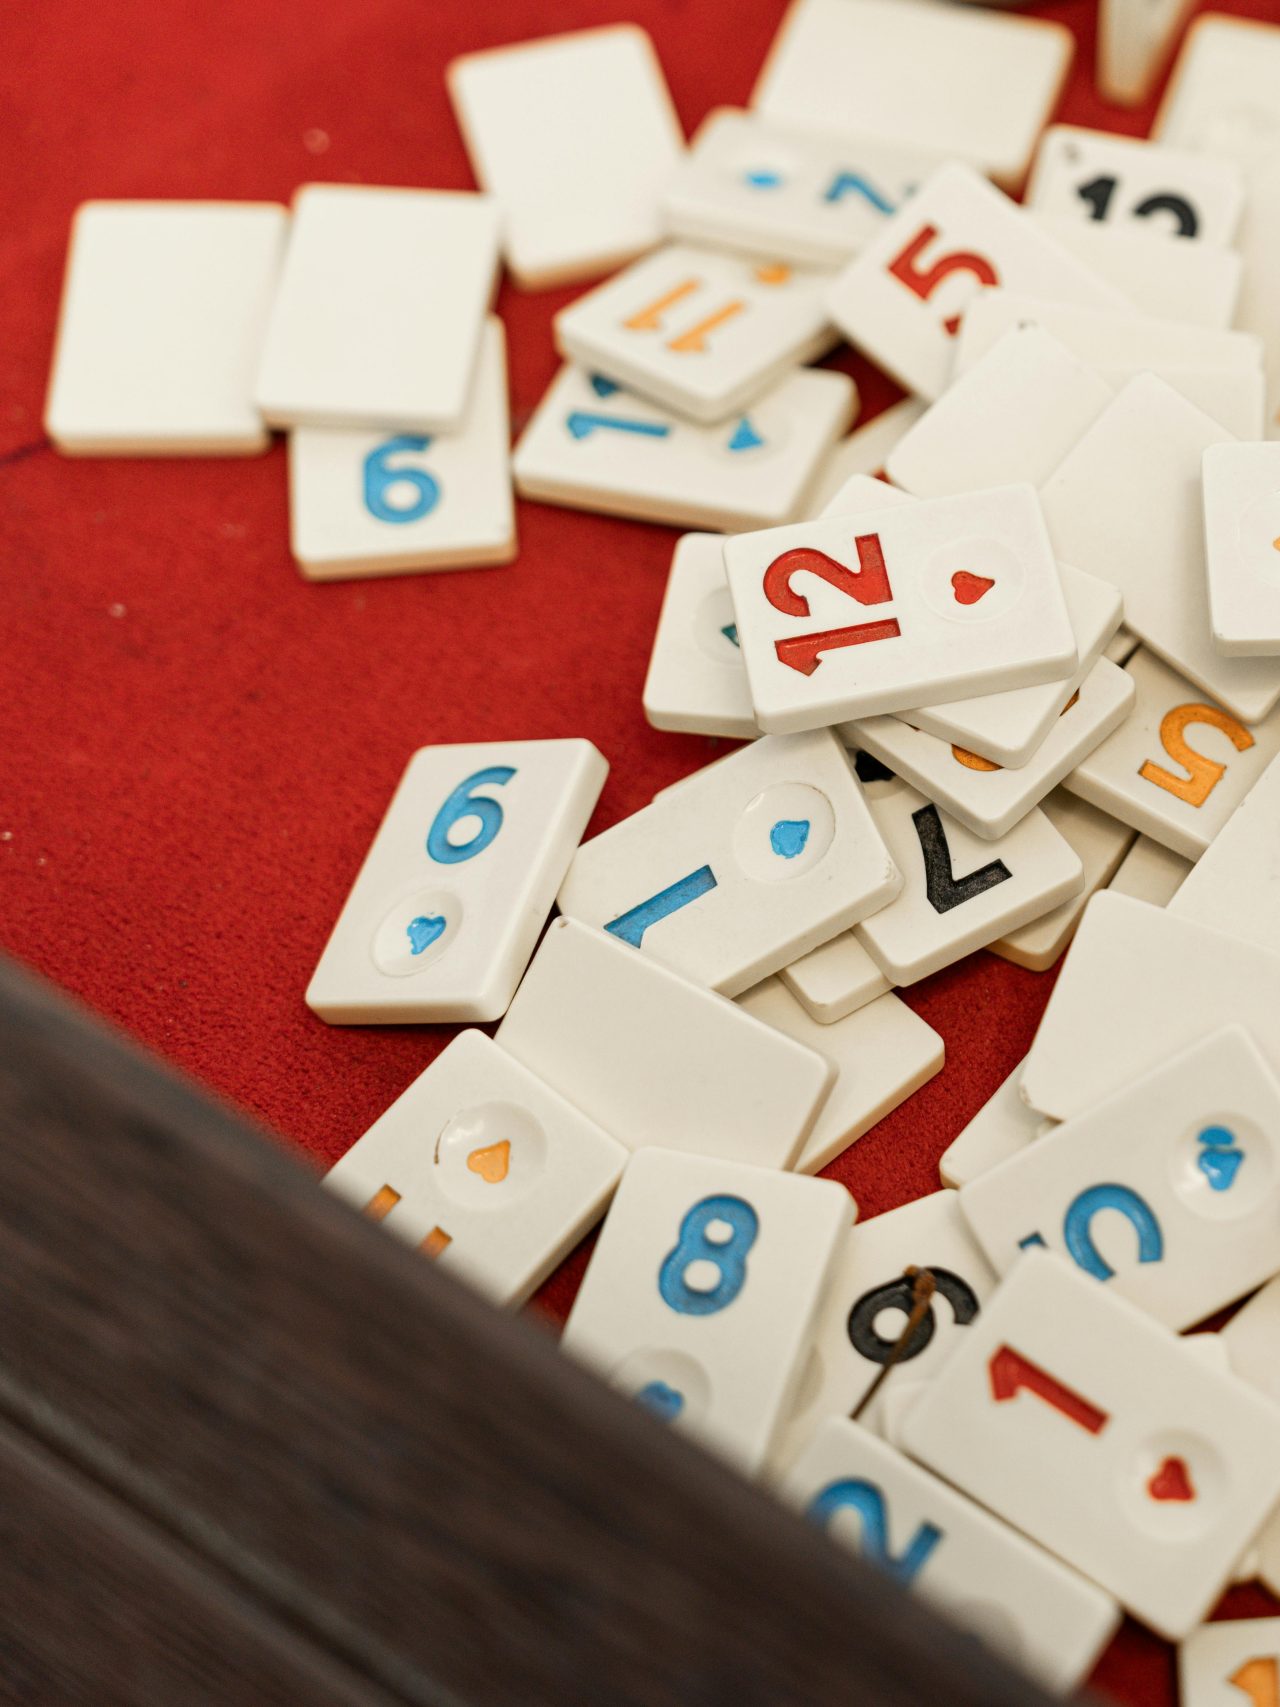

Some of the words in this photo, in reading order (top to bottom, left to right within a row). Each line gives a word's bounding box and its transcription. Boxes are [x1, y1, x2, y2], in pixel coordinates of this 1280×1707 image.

[621, 278, 746, 354] 11
[887, 224, 1000, 337] 5
[761, 532, 902, 678] 12
[1137, 702, 1257, 809] 5
[425, 764, 519, 866] 6
[911, 801, 1014, 915] 7
[656, 1192, 761, 1318] 8
[986, 1341, 1111, 1438] 1
